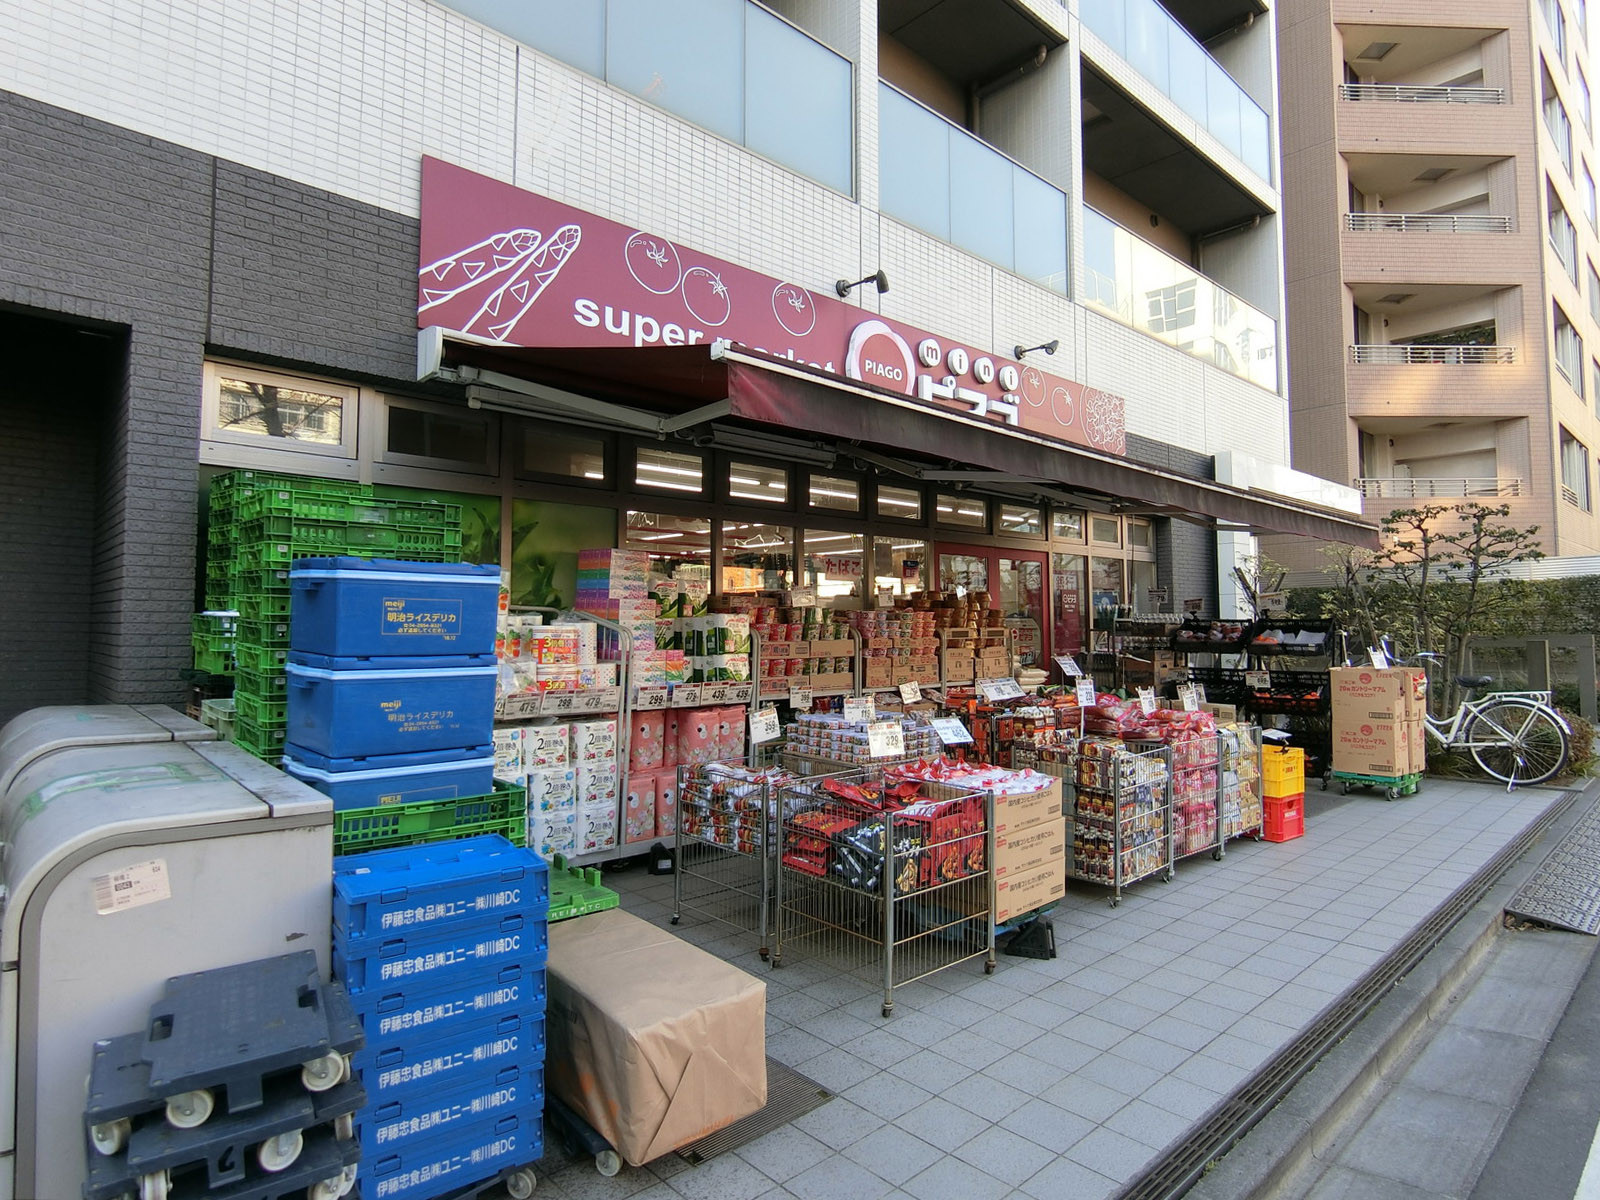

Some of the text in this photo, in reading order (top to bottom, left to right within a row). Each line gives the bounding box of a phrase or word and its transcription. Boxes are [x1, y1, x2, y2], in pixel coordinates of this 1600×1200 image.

[573, 297, 703, 347] super
[865, 360, 902, 380] PIAGO
[925, 344, 1014, 386] mini
[825, 558, 861, 576] たばこ
[385, 600, 405, 608] meiji
[387, 612, 456, 622] 明治ライスデリカ
[712, 690, 725, 699] 439
[736, 690, 748, 698] 439
[381, 700, 401, 709] meiji
[558, 699, 572, 707] 299
[586, 698, 601, 706] 479
[649, 695, 664, 704] 299
[520, 703, 535, 712] 479
[388, 710, 454, 721] 明治ライスデリカ
[537, 738, 564, 750] 2倍巻き
[588, 734, 612, 745] 2倍巻き
[886, 736, 898, 746] 329
[590, 775, 613, 786] 2倍巻き
[545, 782, 571, 794] 2倍巻き
[588, 822, 613, 833] 2倍巻き
